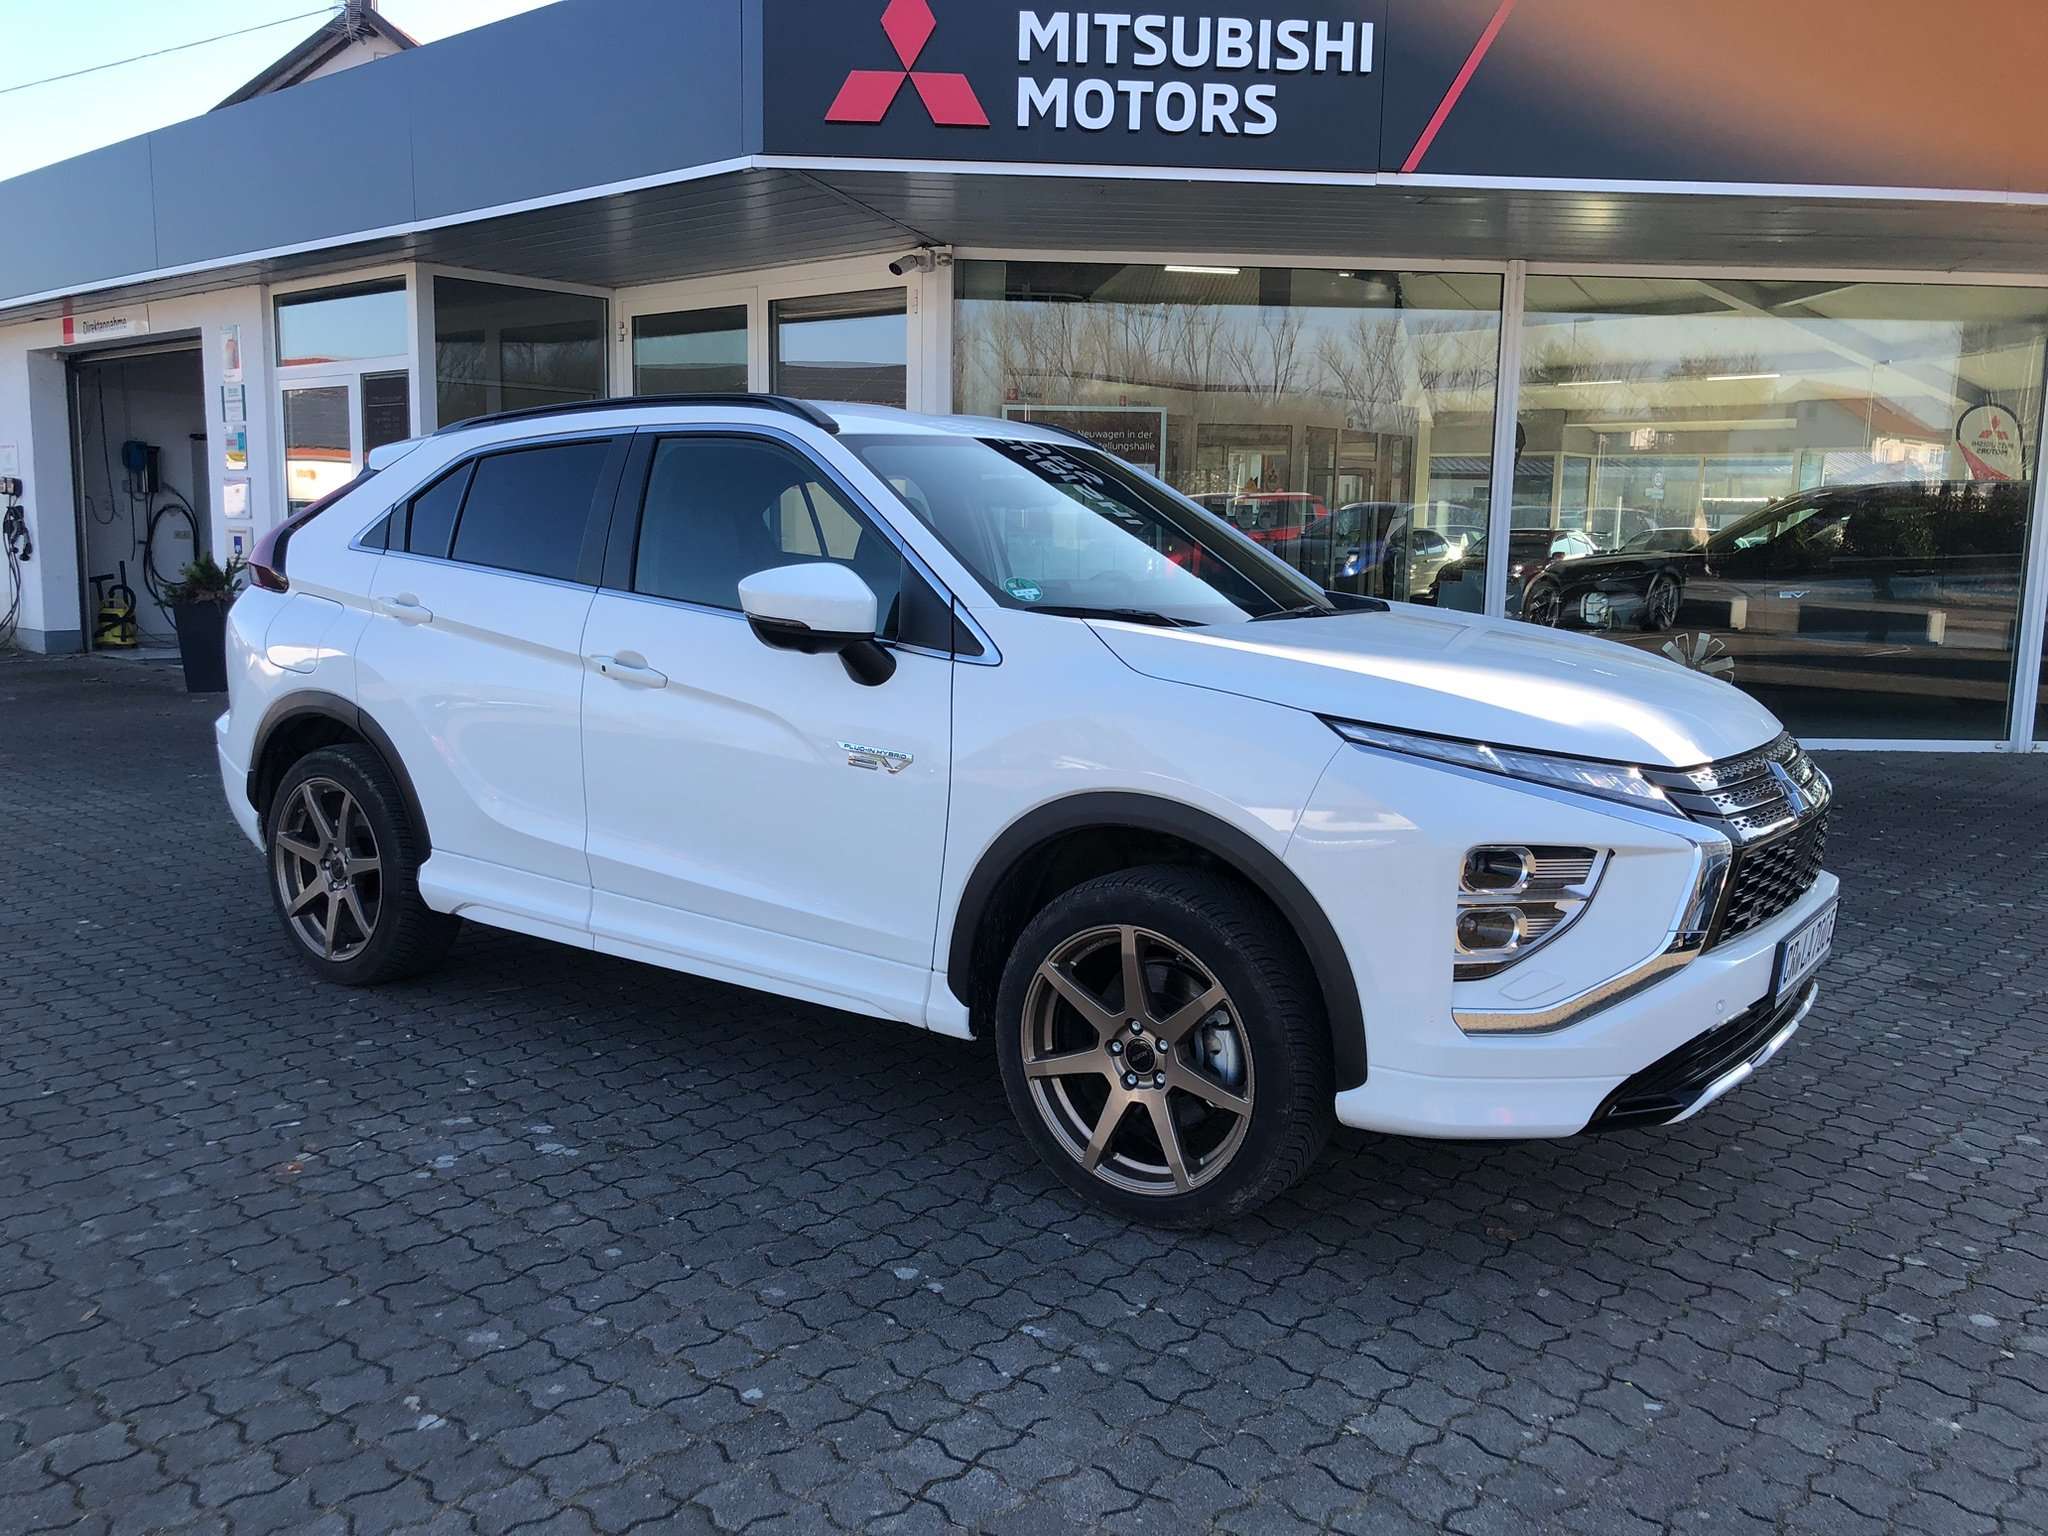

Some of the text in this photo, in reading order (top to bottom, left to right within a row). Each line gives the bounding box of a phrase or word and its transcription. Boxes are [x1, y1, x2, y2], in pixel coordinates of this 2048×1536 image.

[1018, 11, 1374, 73] MITSUBISHI
[1017, 76, 1278, 135] MOTORS
[1078, 429, 1153, 440] Neuwagen in der
[844, 743, 907, 760] PLUG-IN HYBRID
